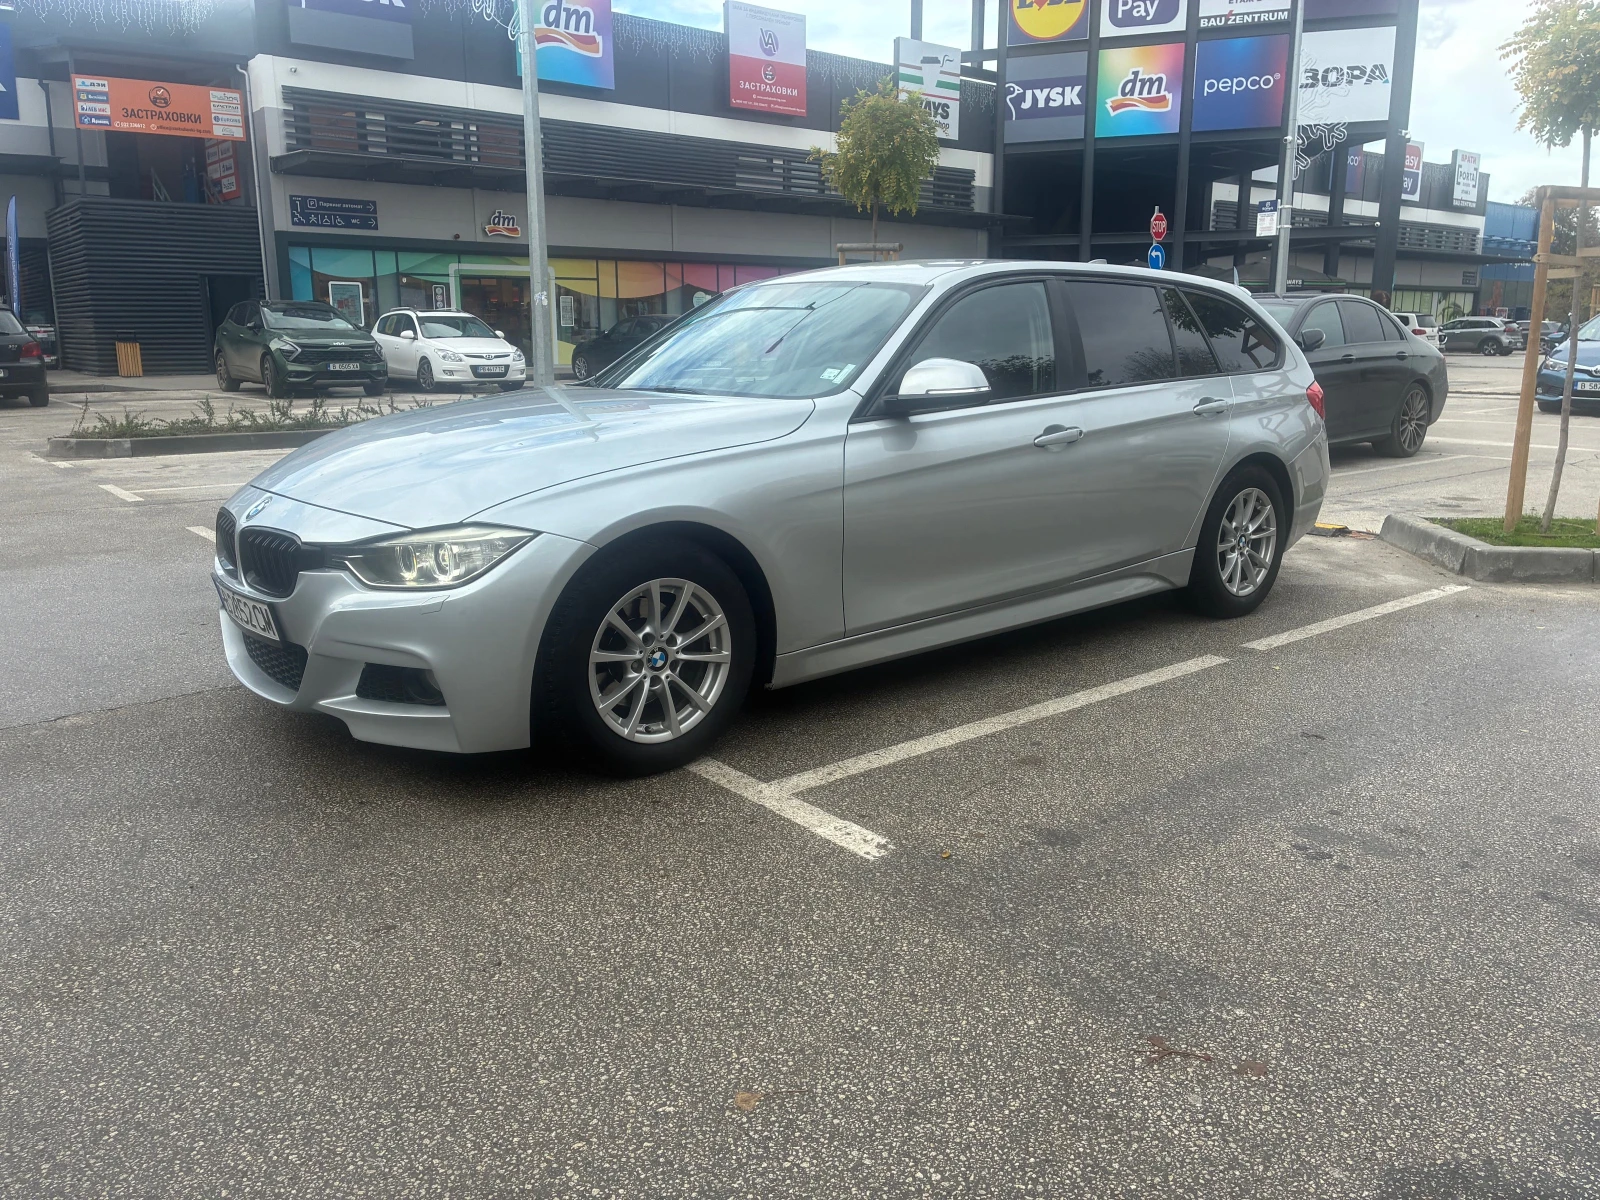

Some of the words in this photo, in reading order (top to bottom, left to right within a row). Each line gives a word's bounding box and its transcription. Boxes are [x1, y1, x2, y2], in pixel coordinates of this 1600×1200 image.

[544, 0, 591, 34] dm
[1200, 17, 1225, 27] BAU
[1227, 11, 1289, 25] ZENTRUM
[739, 80, 798, 97] ЗАСТРАХОВКИ
[1121, 70, 1165, 98] dm
[1020, 85, 1083, 110] JYSK
[121, 107, 202, 124] ЗАСТРАХОВКИ
[920, 100, 950, 120] AYS
[491, 210, 516, 227] dm
[1152, 220, 1166, 233] STOP
